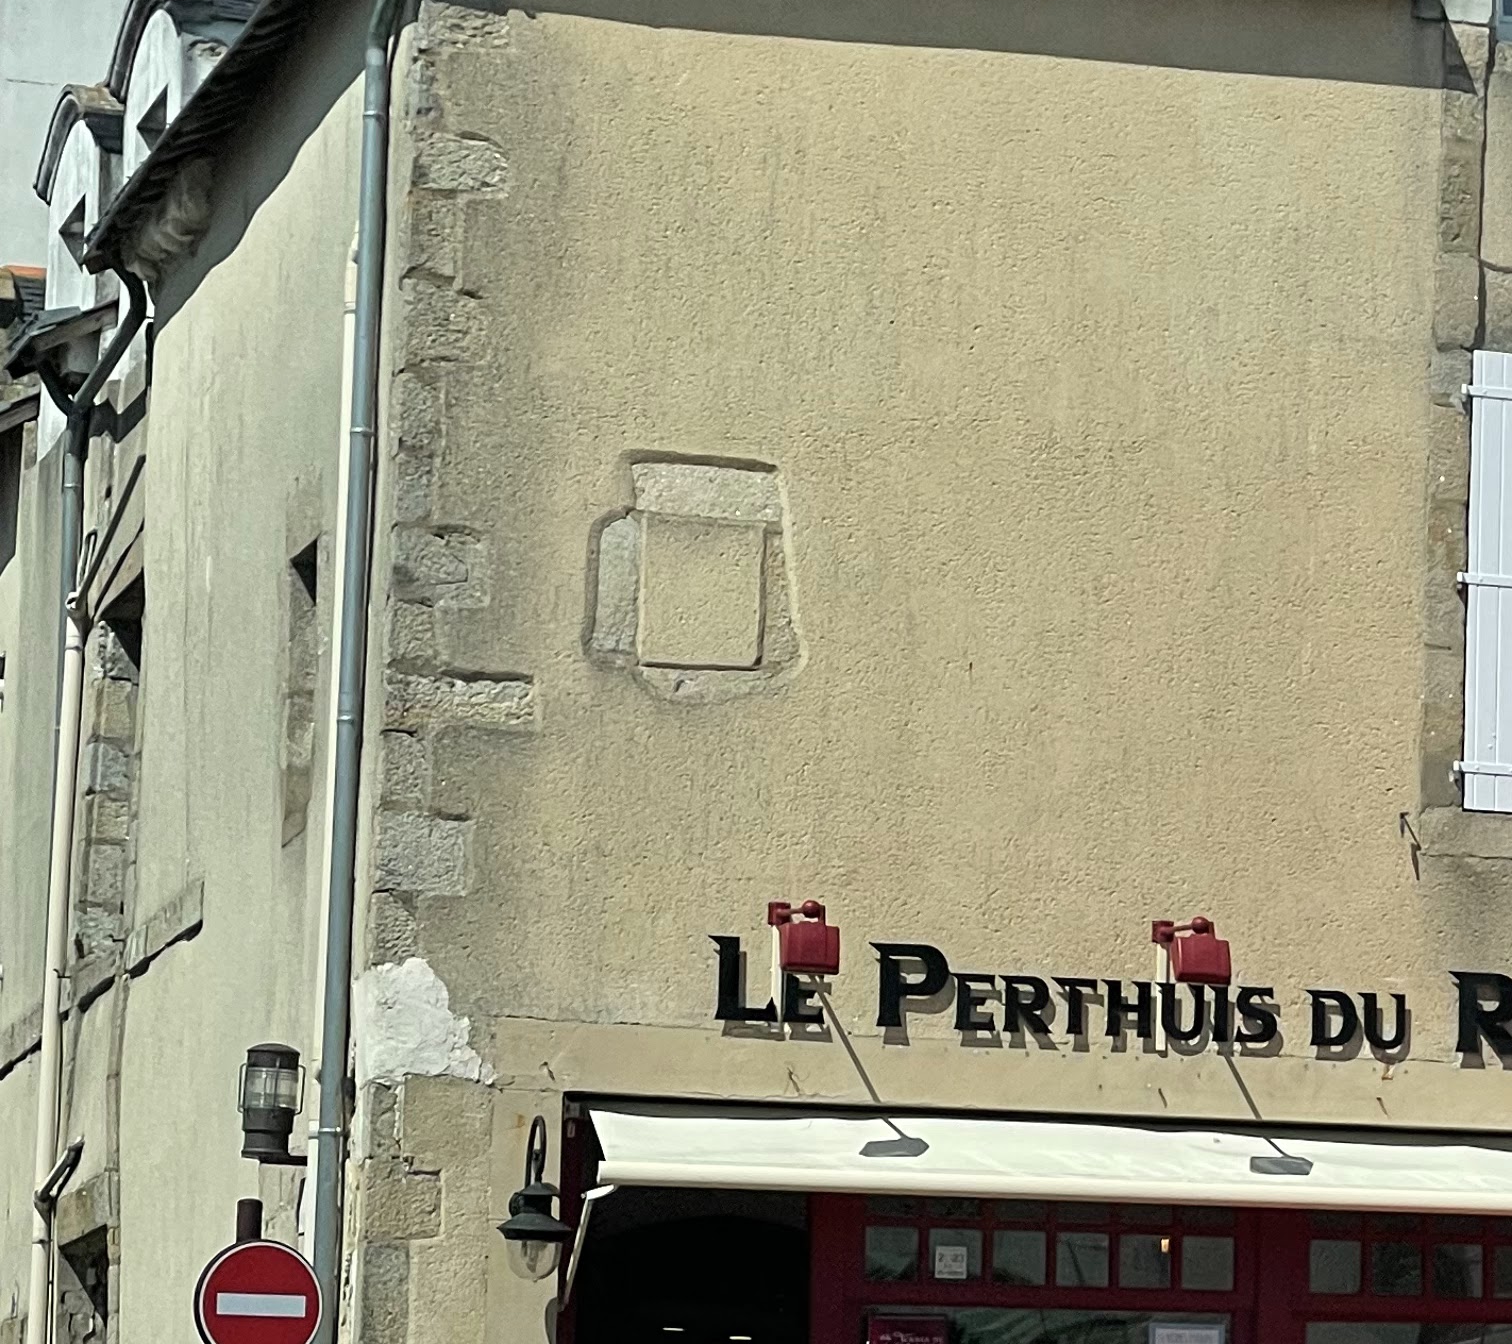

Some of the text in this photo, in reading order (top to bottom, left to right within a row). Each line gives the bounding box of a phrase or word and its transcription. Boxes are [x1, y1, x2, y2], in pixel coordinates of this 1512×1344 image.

[708, 935, 825, 1024] LE
[869, 941, 1278, 1043] PERTHUIS
[1305, 988, 1407, 1050] DU
